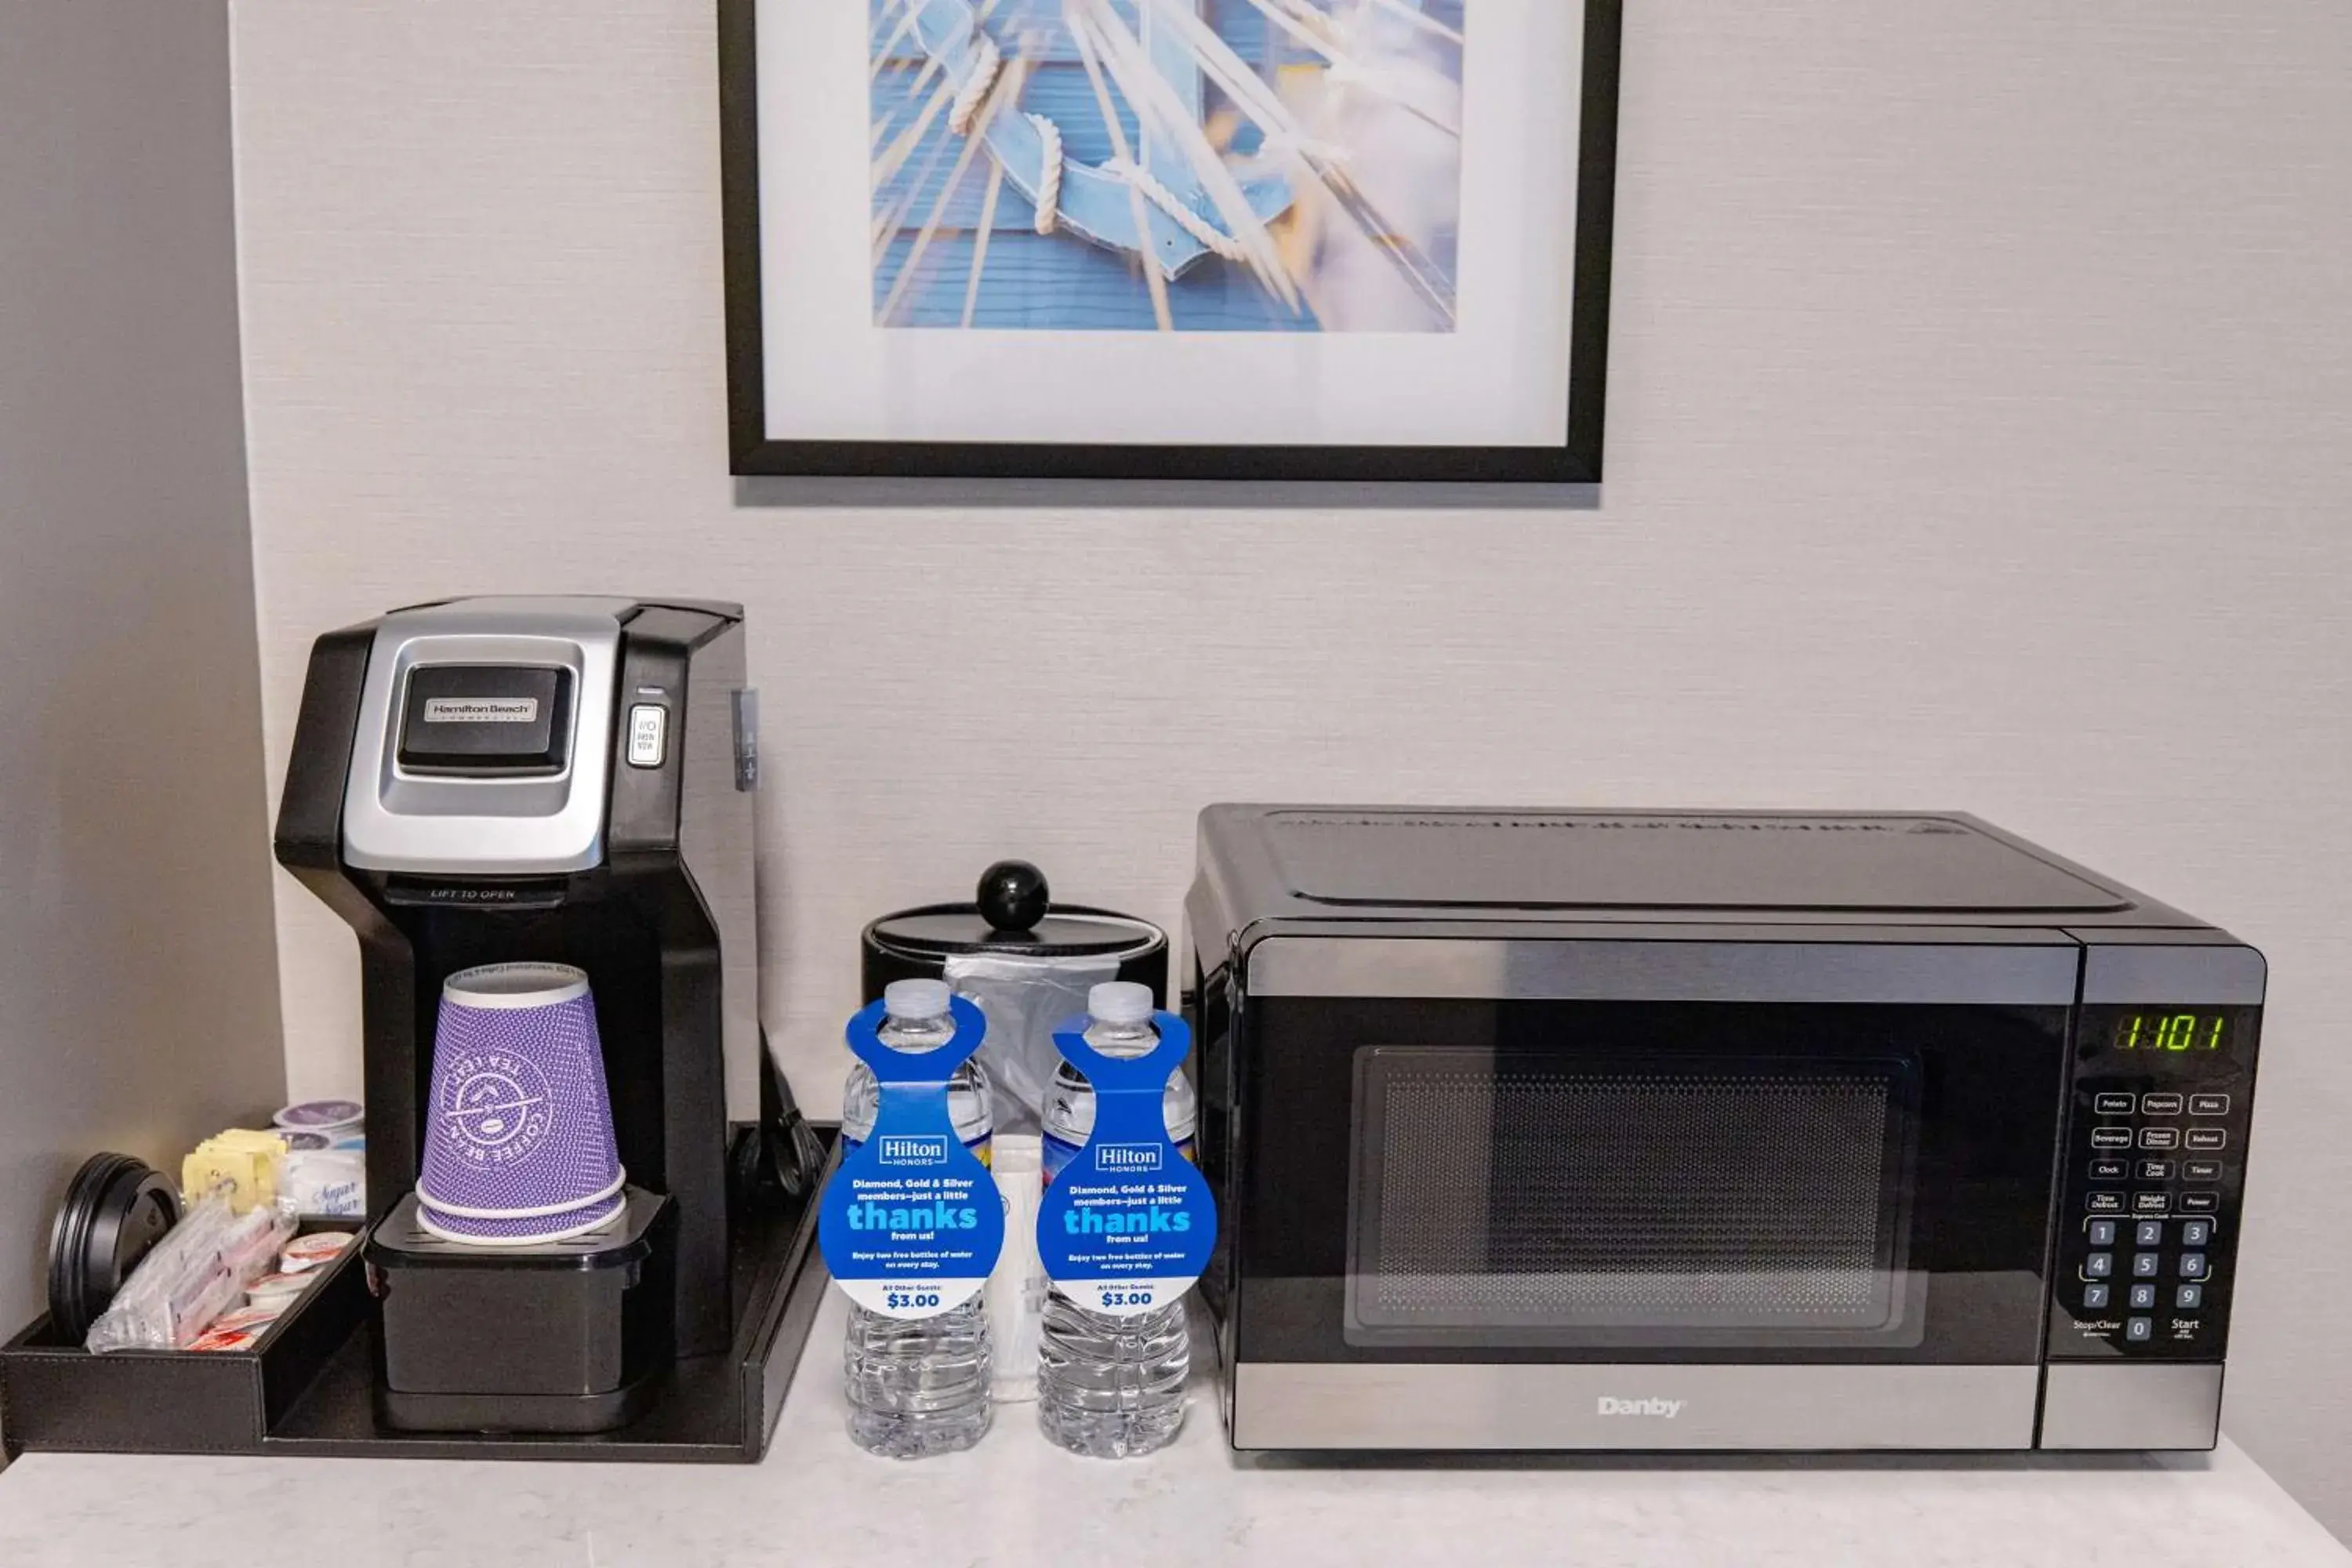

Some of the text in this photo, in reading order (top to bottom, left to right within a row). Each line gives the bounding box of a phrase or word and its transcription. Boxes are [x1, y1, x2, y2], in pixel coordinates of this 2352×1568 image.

[434, 705, 528, 713] Hamilton Beach
[430, 890, 516, 899] LIFT TO OPEN
[884, 1141, 942, 1156] Hilton
[1102, 1148, 1156, 1164] Hilton
[852, 1178, 974, 1189] Diamond, Gold & Silver
[1069, 1184, 1187, 1195] Diamond, Gold & Silver
[312, 1181, 357, 1204] Sugar
[943, 1191, 969, 1200] little
[1157, 1196, 1182, 1205] little
[847, 1200, 978, 1230] thanks
[1063, 1205, 1191, 1235] thanks
[891, 1231, 935, 1240] from us!
[1106, 1234, 1149, 1243] from us!
[2099, 1227, 2106, 1240] 1
[2144, 1227, 2154, 1240] 2
[2190, 1227, 2200, 1240] 3
[2092, 1259, 2103, 1272] 4
[2141, 1258, 2151, 1272] 5
[2187, 1258, 2197, 1272] 6
[887, 1293, 940, 1309] $3.00
[1102, 1291, 1152, 1307] $3.00
[2092, 1290, 2101, 1302] 7
[2137, 1290, 2147, 1303] 8
[2183, 1290, 2194, 1303] 9
[2073, 1320, 2121, 1330] Stop/Clear
[2133, 1322, 2144, 1335] 0
[2171, 1319, 2200, 1329] Start
[1597, 1396, 1681, 1419] Danby
